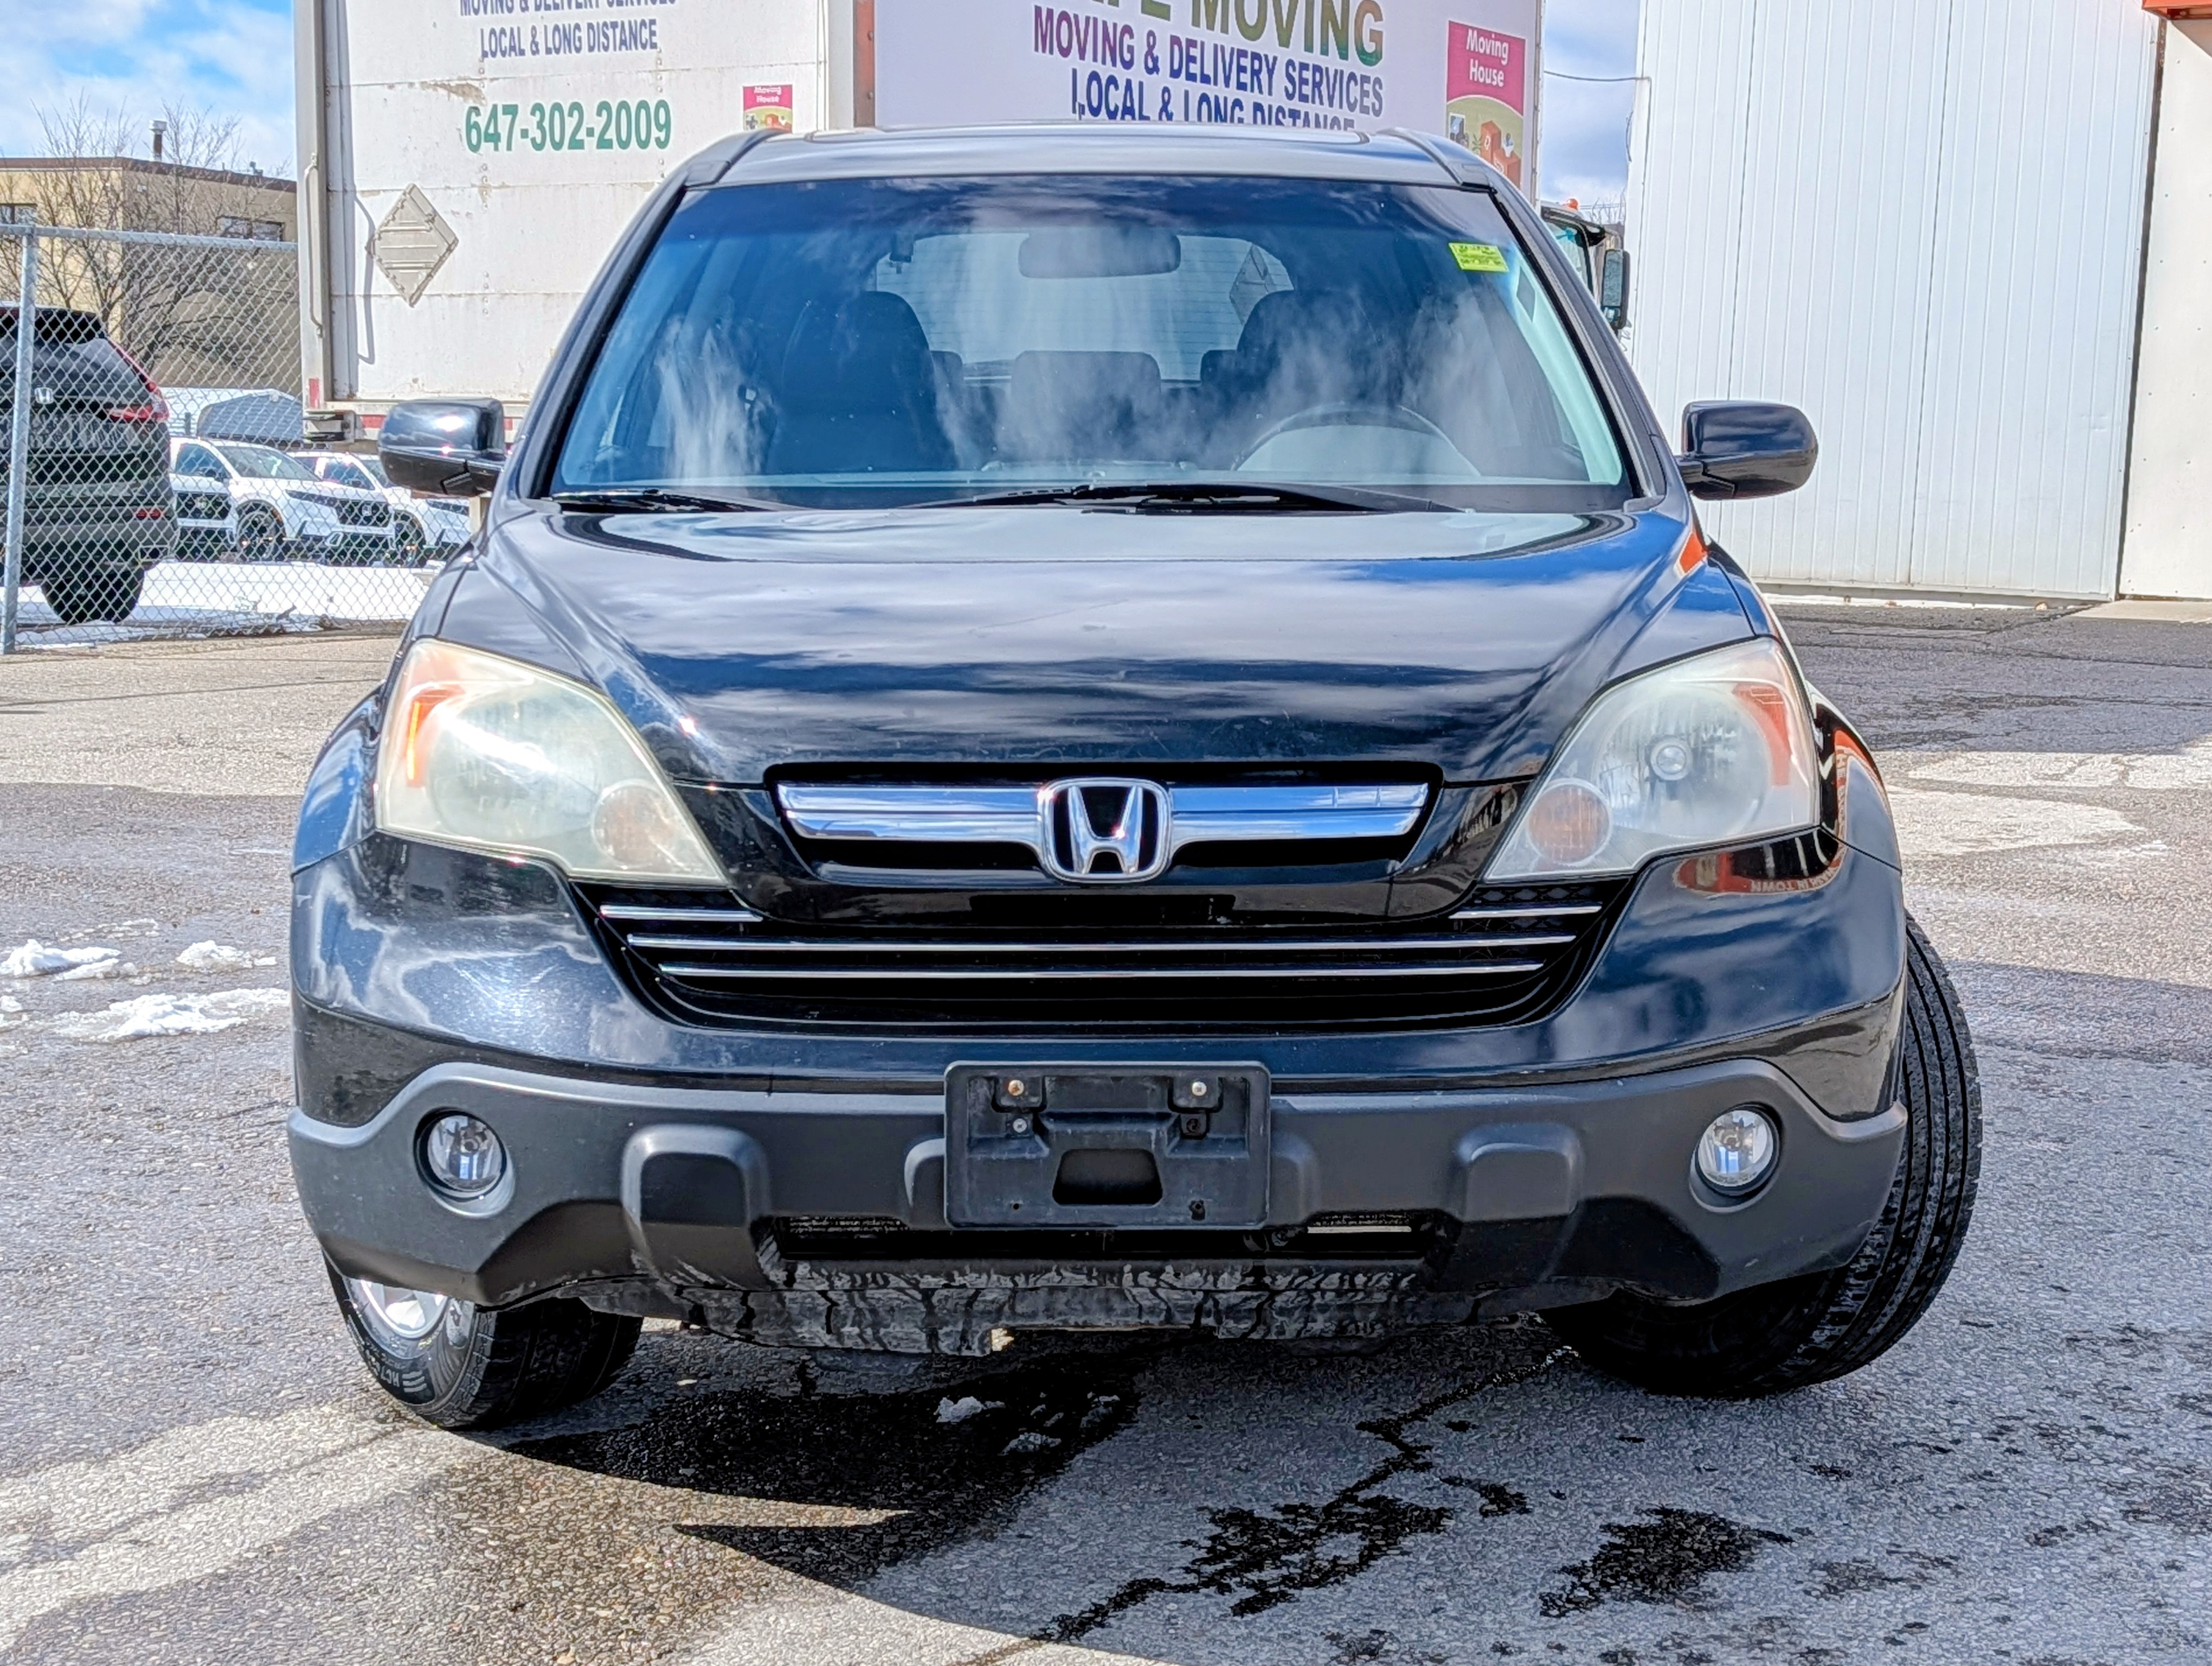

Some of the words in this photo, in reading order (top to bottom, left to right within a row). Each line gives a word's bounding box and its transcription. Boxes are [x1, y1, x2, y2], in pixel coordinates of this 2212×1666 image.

[480, 26, 526, 58] LOCAL
[530, 25, 539, 56] &
[544, 22, 582, 55] LONG
[587, 18, 658, 53] DISTANCE
[1034, 5, 1134, 71] MOVING
[1144, 29, 1160, 75] &
[1169, 34, 1278, 97] DELIVERY
[1284, 58, 1383, 117] SERVICES
[1466, 29, 1509, 66] Moving
[1072, 67, 1150, 120] LOCAL
[1159, 86, 1174, 121] &
[1469, 59, 1504, 87] House
[465, 99, 672, 153] 647-302-2009
